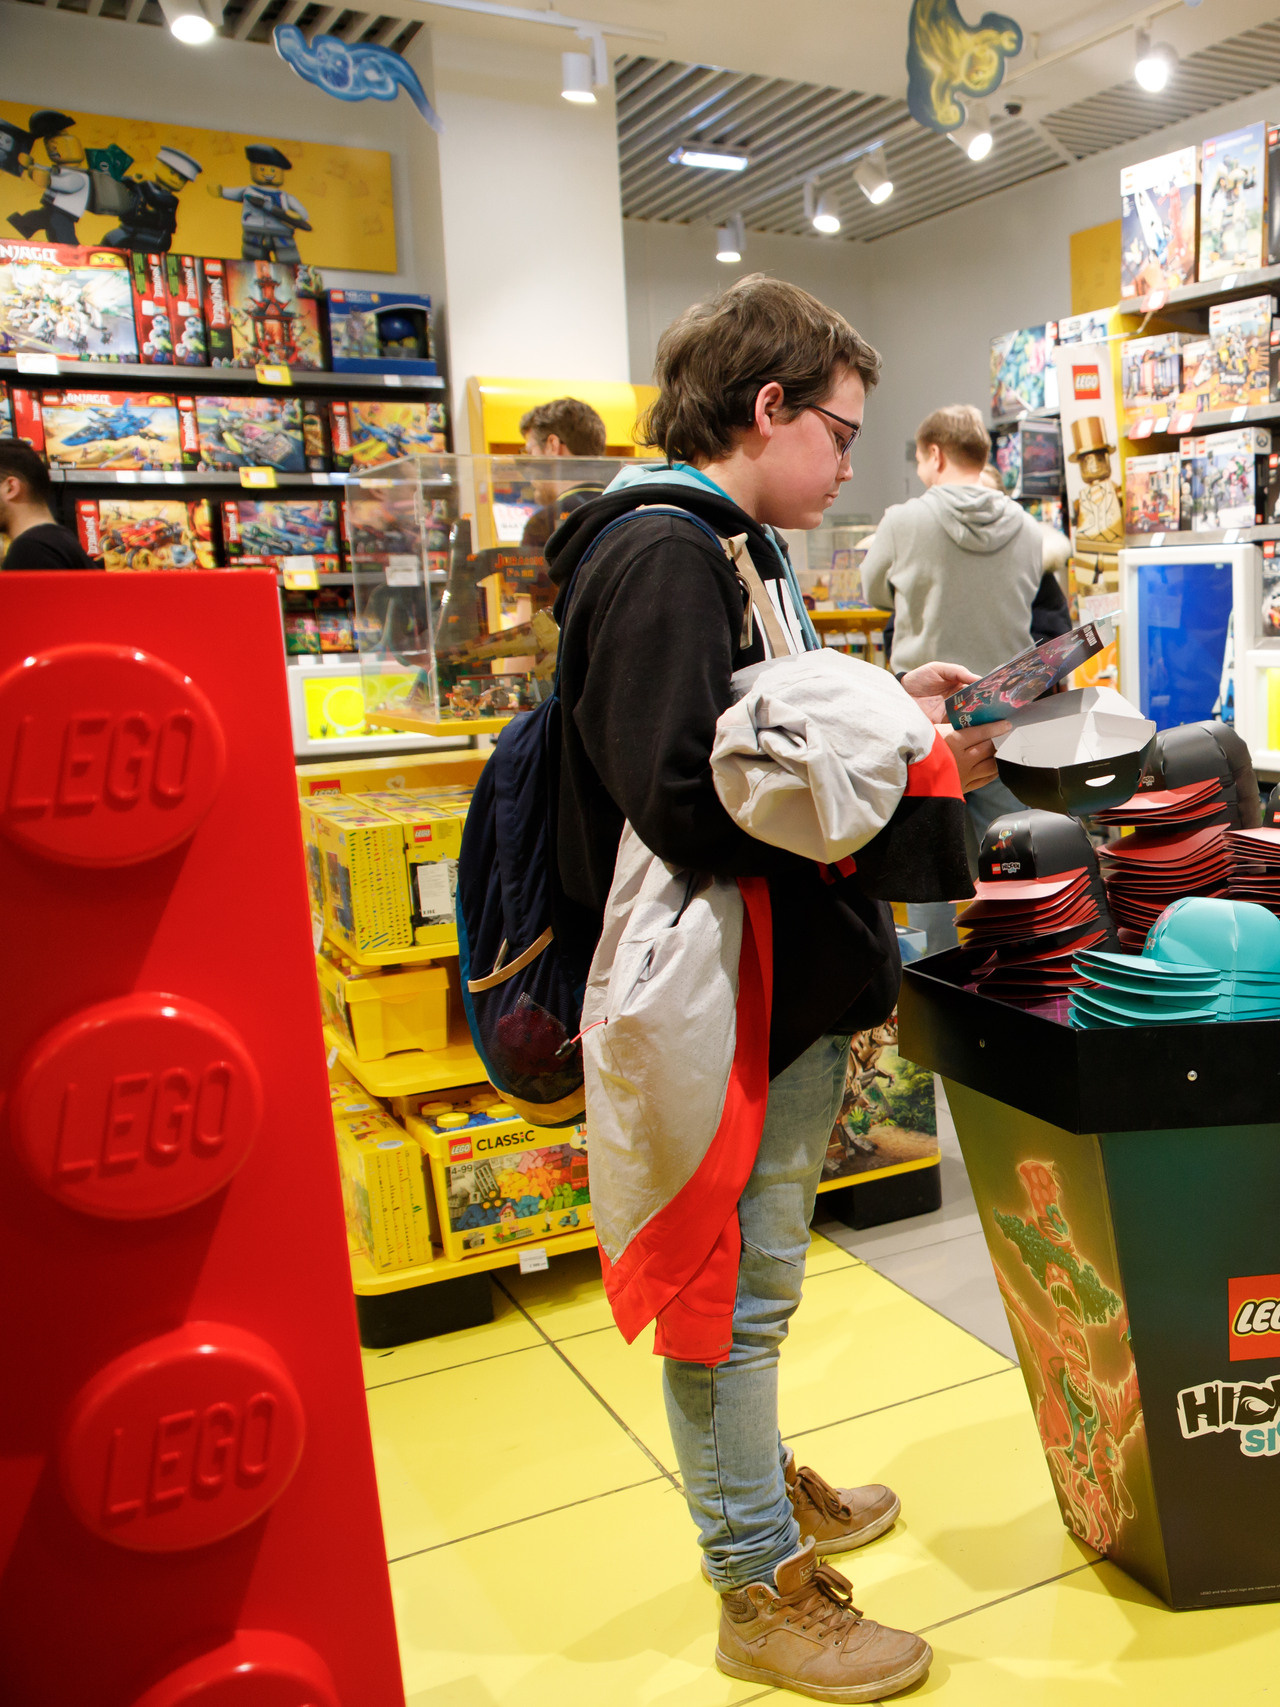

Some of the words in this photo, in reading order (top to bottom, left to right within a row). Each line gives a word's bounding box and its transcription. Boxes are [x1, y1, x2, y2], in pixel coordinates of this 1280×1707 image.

[1073, 374, 1099, 390] LEGO
[5, 708, 198, 818] LEGO
[54, 1060, 235, 1180] LEGO
[450, 1143, 472, 1156] LEGO
[476, 1129, 536, 1151] CLASSIC
[451, 1164, 473, 1175] 4-99
[103, 1390, 279, 1523] LEGO
